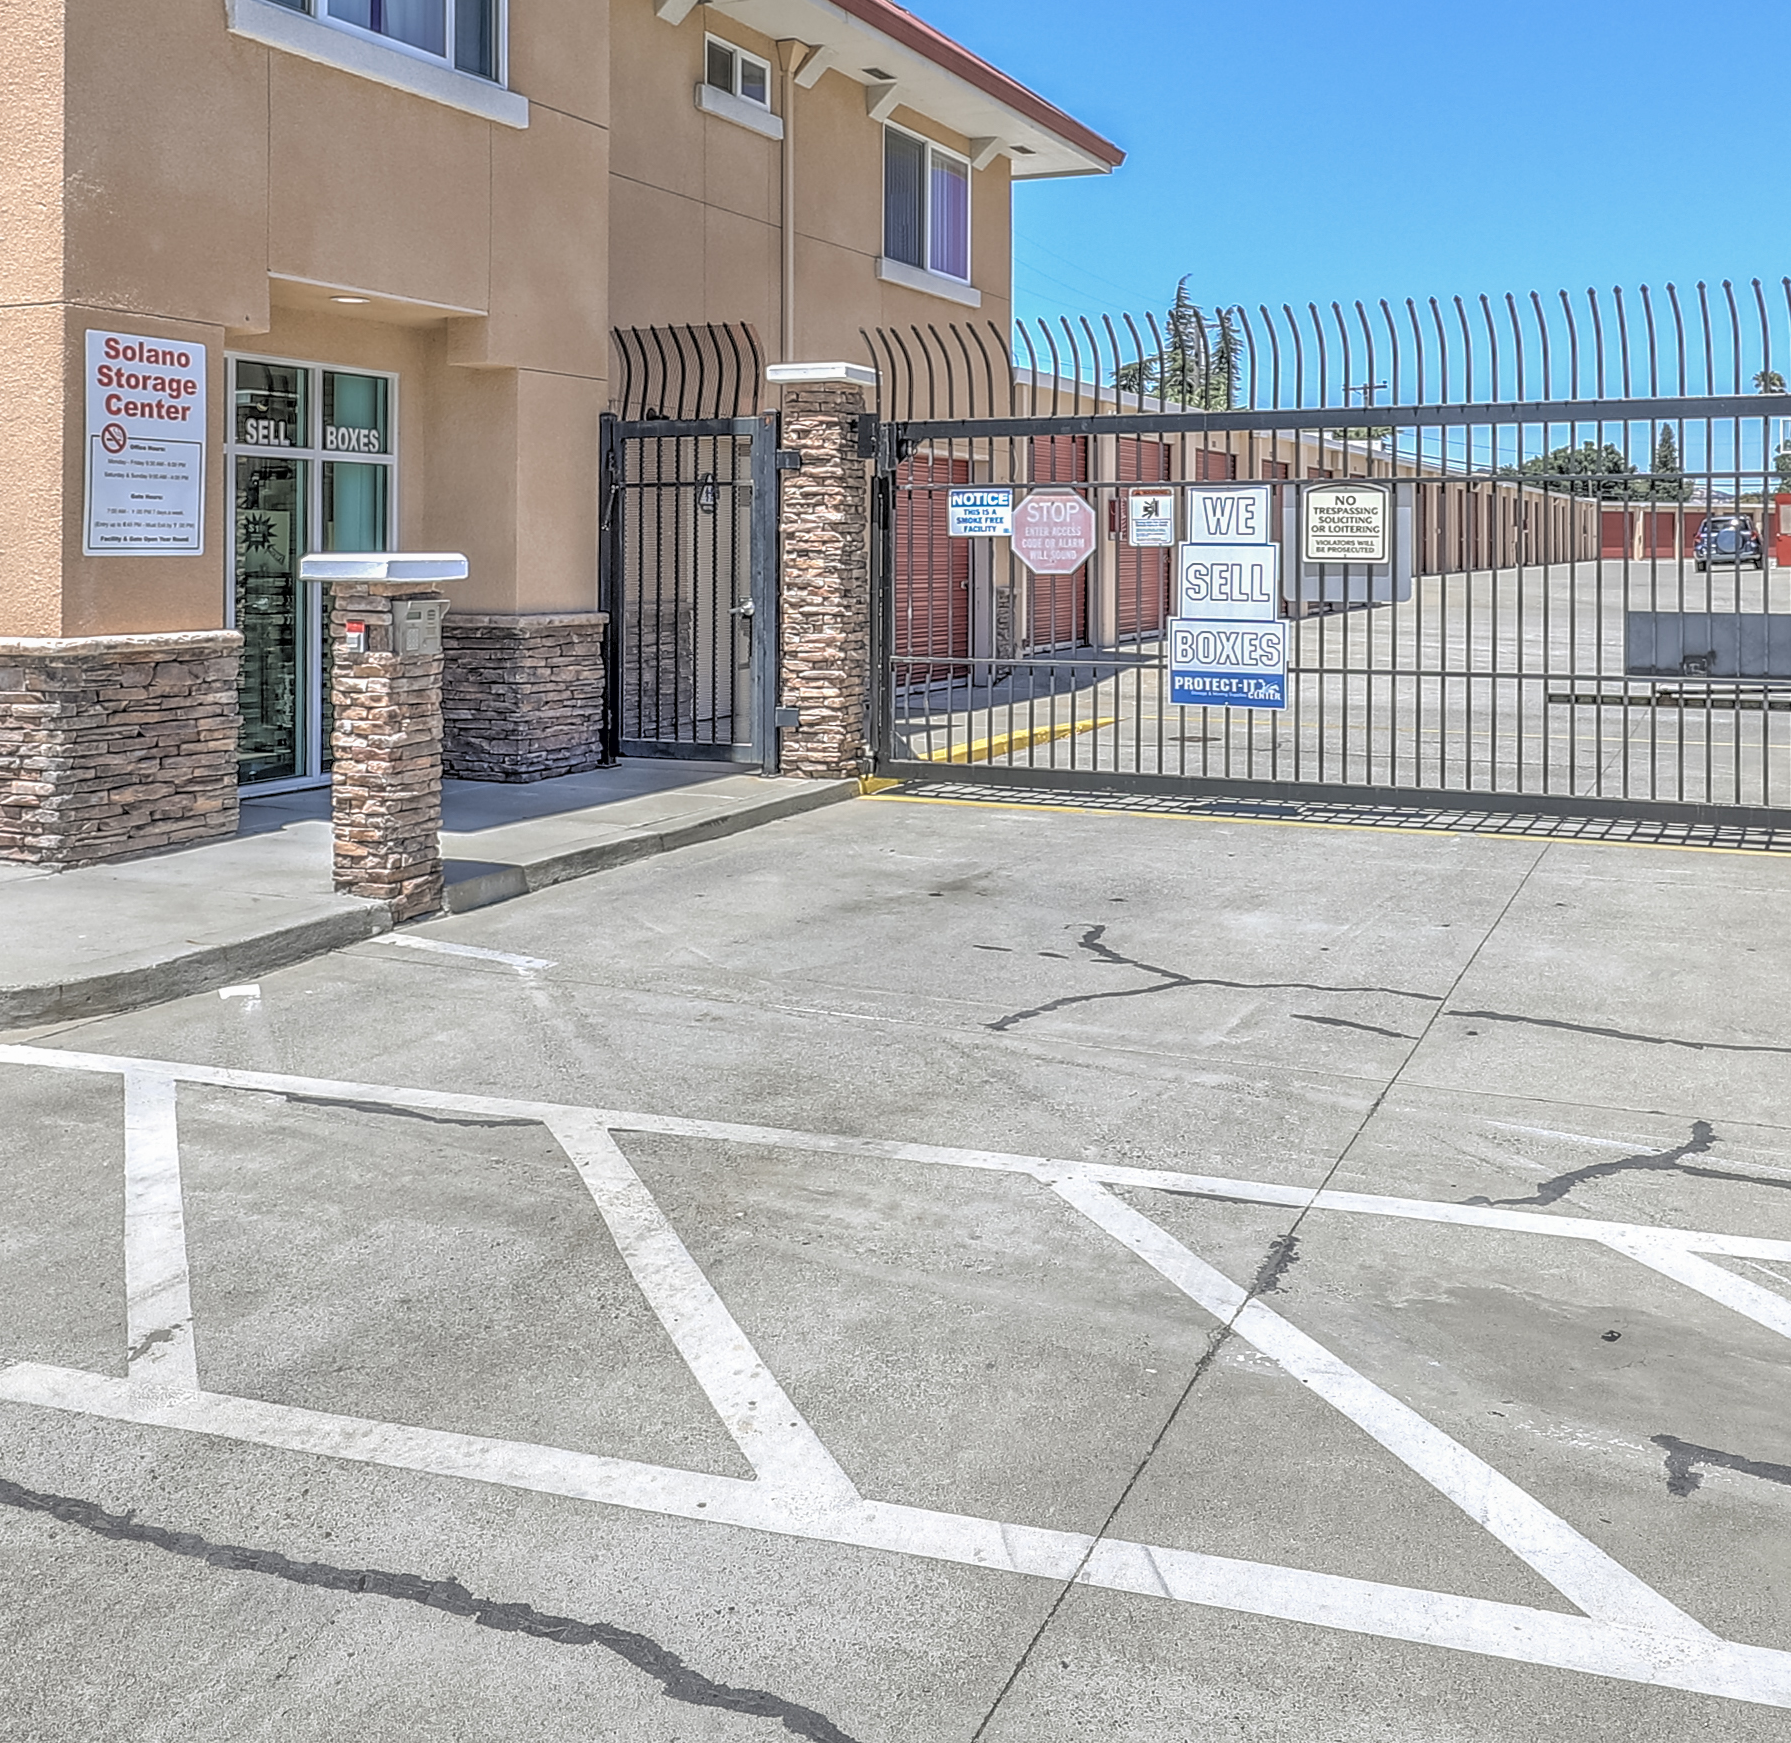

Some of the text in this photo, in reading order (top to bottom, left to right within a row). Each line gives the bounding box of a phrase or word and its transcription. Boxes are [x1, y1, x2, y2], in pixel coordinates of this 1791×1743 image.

[104, 337, 191, 368] Solano
[96, 364, 198, 400] Storage
[105, 393, 192, 422] Center
[245, 417, 379, 453] SELL BOXES
[952, 492, 1009, 506] NOTICE
[1334, 495, 1357, 506] NO
[1026, 502, 1080, 523] STOP
[1202, 497, 1256, 536] WE
[1313, 507, 1378, 515] TRESPASSING
[1318, 516, 1373, 524] SOLICITING
[1025, 526, 1081, 536] ENTER ACCESS
[1311, 525, 1380, 533] OR LOITERING
[1021, 538, 1085, 548] CODE OR ALARM
[1030, 550, 1077, 560] WILL SOUND
[1185, 562, 1270, 602] SELL
[1174, 630, 1281, 667] BOXES
[1174, 676, 1257, 693] PROTECT-IT
